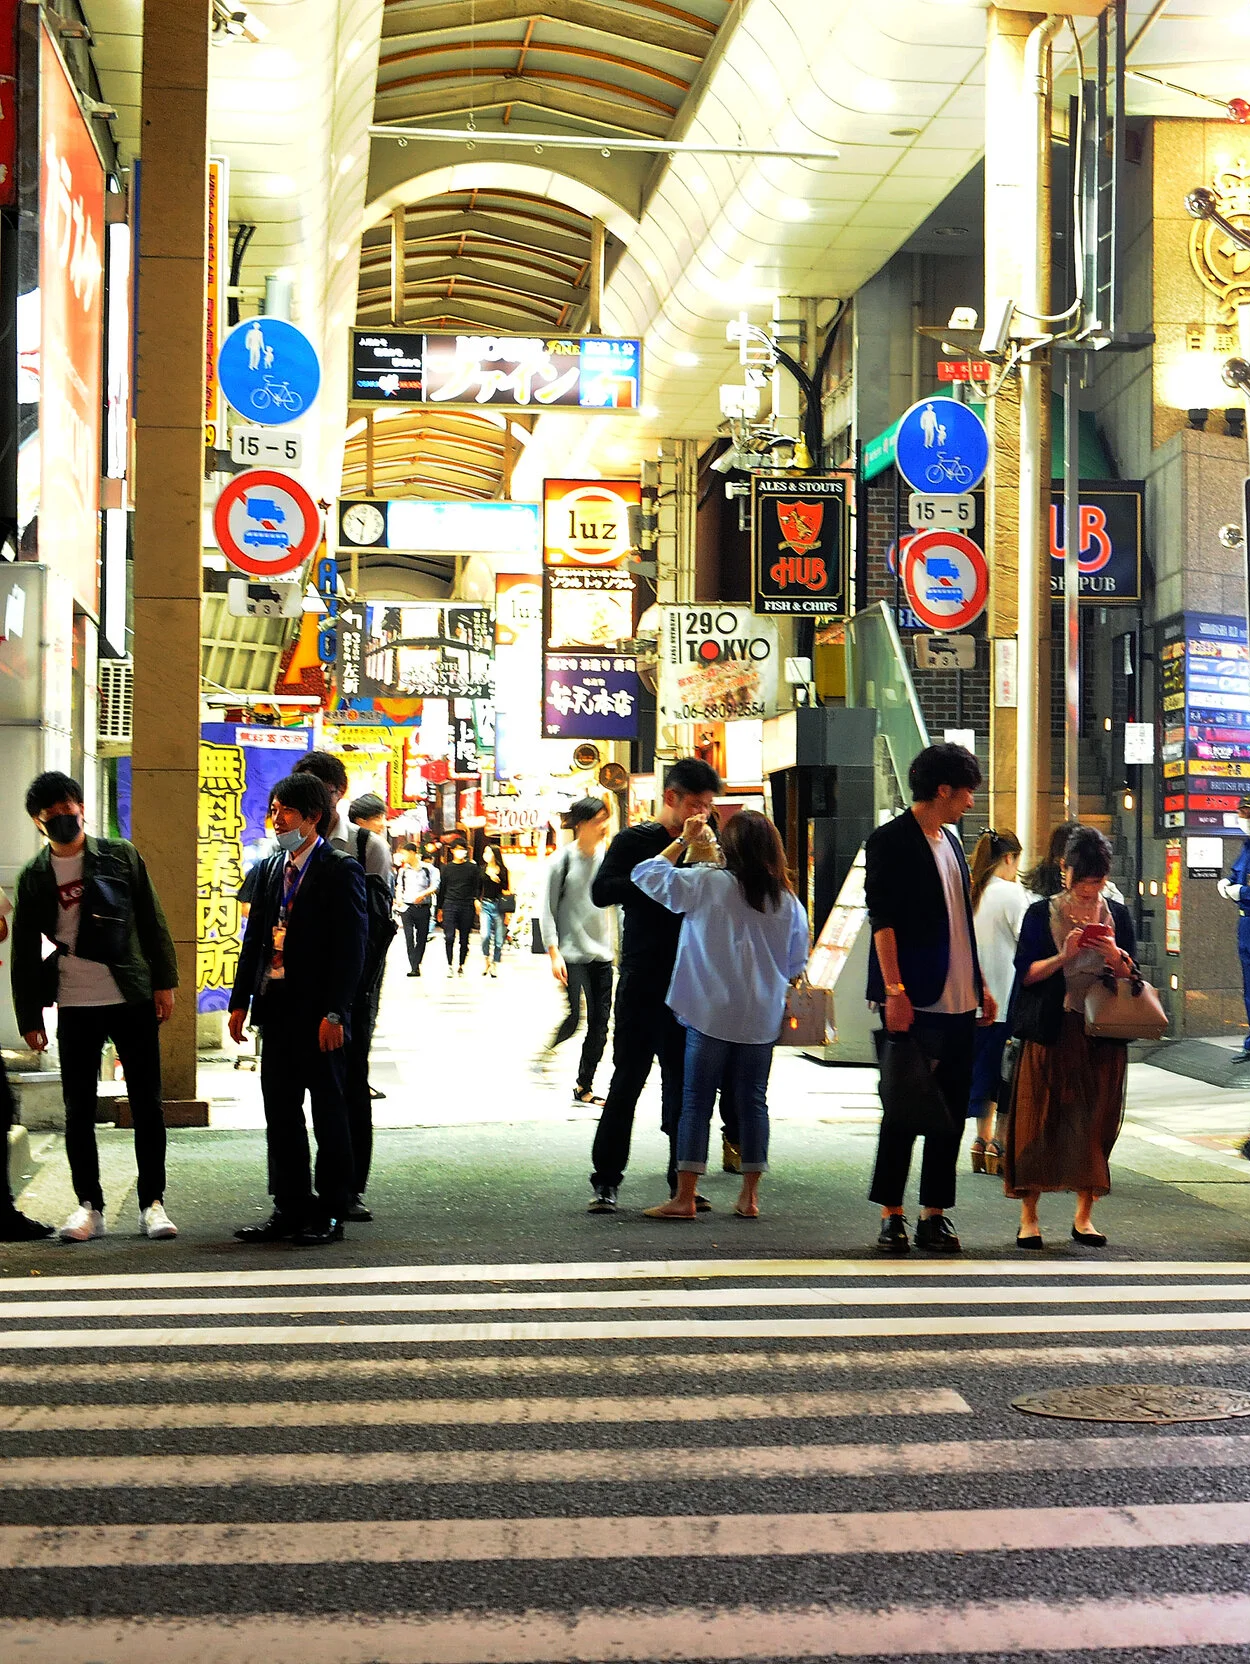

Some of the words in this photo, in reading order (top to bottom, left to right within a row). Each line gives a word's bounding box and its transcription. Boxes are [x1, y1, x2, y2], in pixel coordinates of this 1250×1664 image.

[758, 482, 787, 491] ALES
[788, 482, 797, 491] &
[798, 482, 843, 492] STOUTS
[568, 510, 617, 539] luz
[770, 557, 828, 591] HUB
[1079, 576, 1116, 592] PUB
[764, 601, 791, 611] FISH
[792, 602, 801, 611] &
[803, 602, 838, 611] CHIPS
[686, 638, 770, 661] TOKYO
[197, 744, 244, 988] 無料案内所
